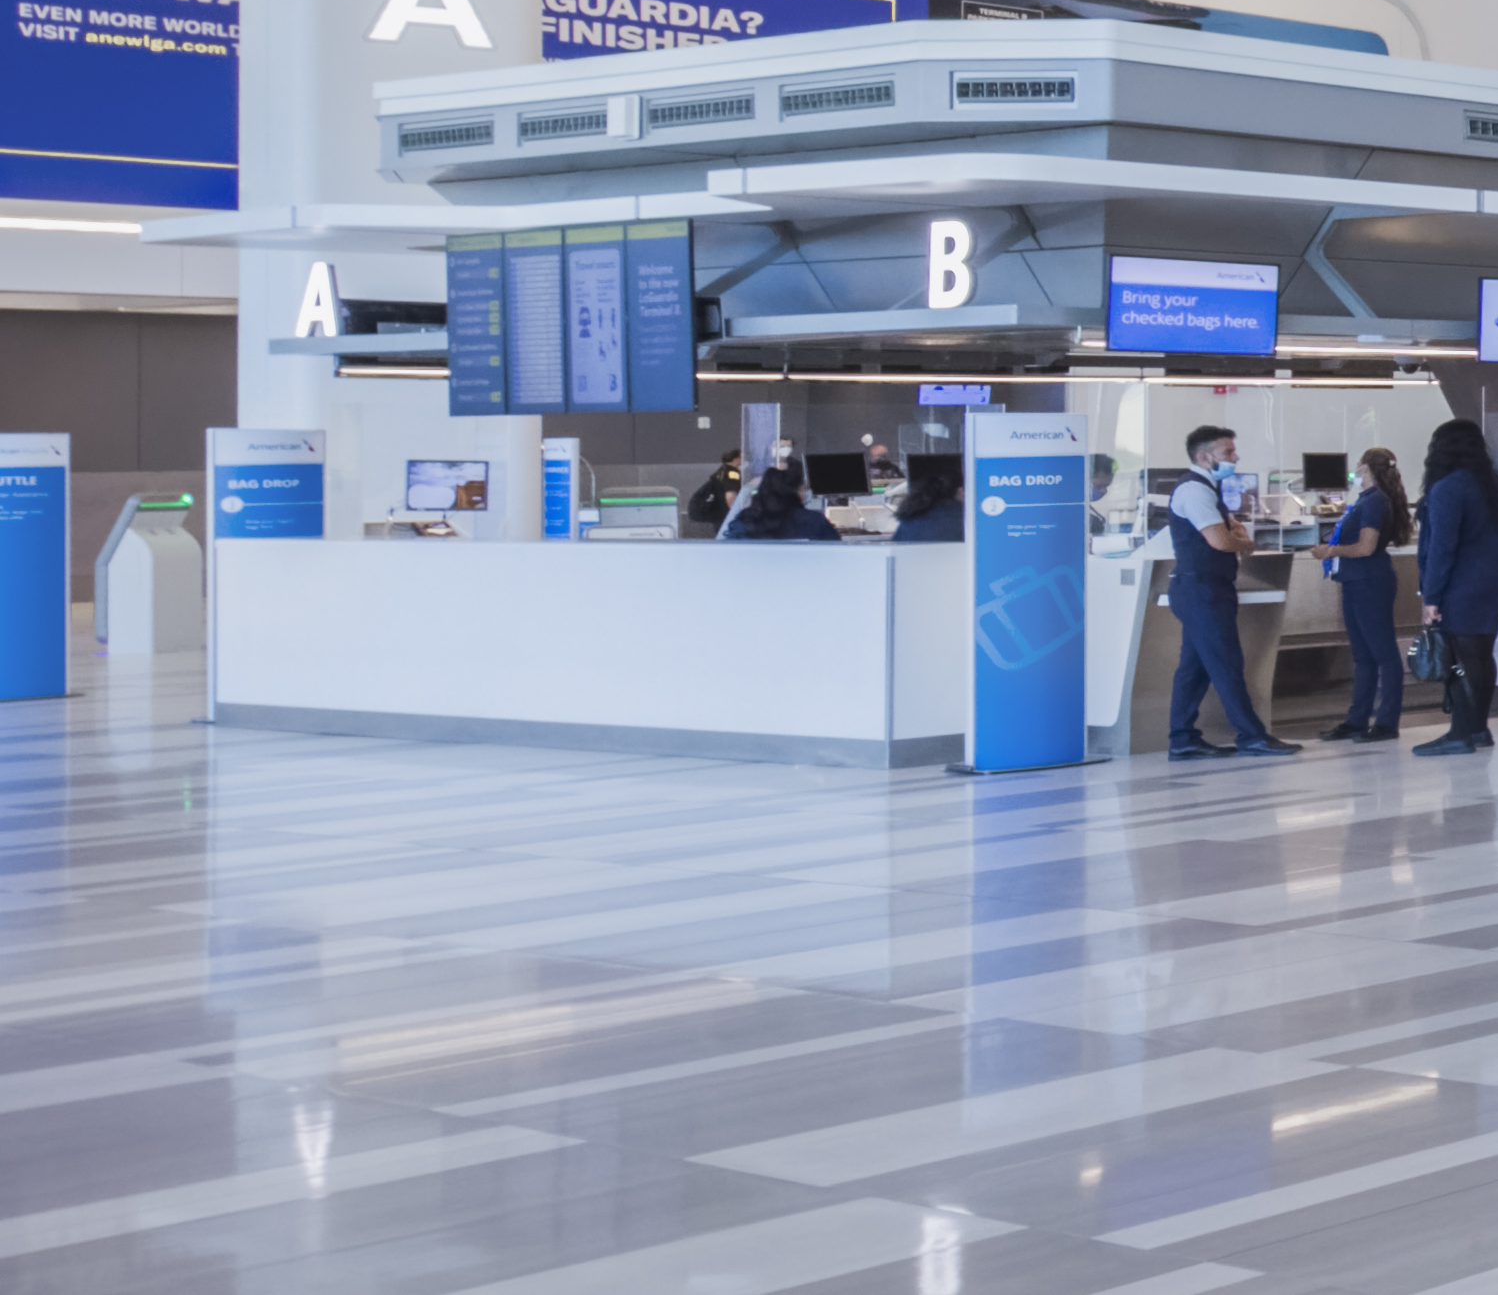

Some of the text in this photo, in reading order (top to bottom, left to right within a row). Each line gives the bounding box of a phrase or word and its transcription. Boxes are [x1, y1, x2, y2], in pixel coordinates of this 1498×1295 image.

[18, 3, 83, 23] EVEN
[89, 10, 157, 30] MORE
[18, 22, 79, 42] VISIT
[85, 32, 227, 55] anewlga.com
[928, 219, 973, 309] B
[1216, 271, 1255, 282] American
[295, 261, 337, 339] A
[1122, 290, 1199, 310] Bring your
[1121, 311, 1260, 332] checked bags here.
[1009, 430, 1064, 441] American
[228, 478, 299, 489] BAG DROP
[989, 475, 1062, 487] BAG DROP
